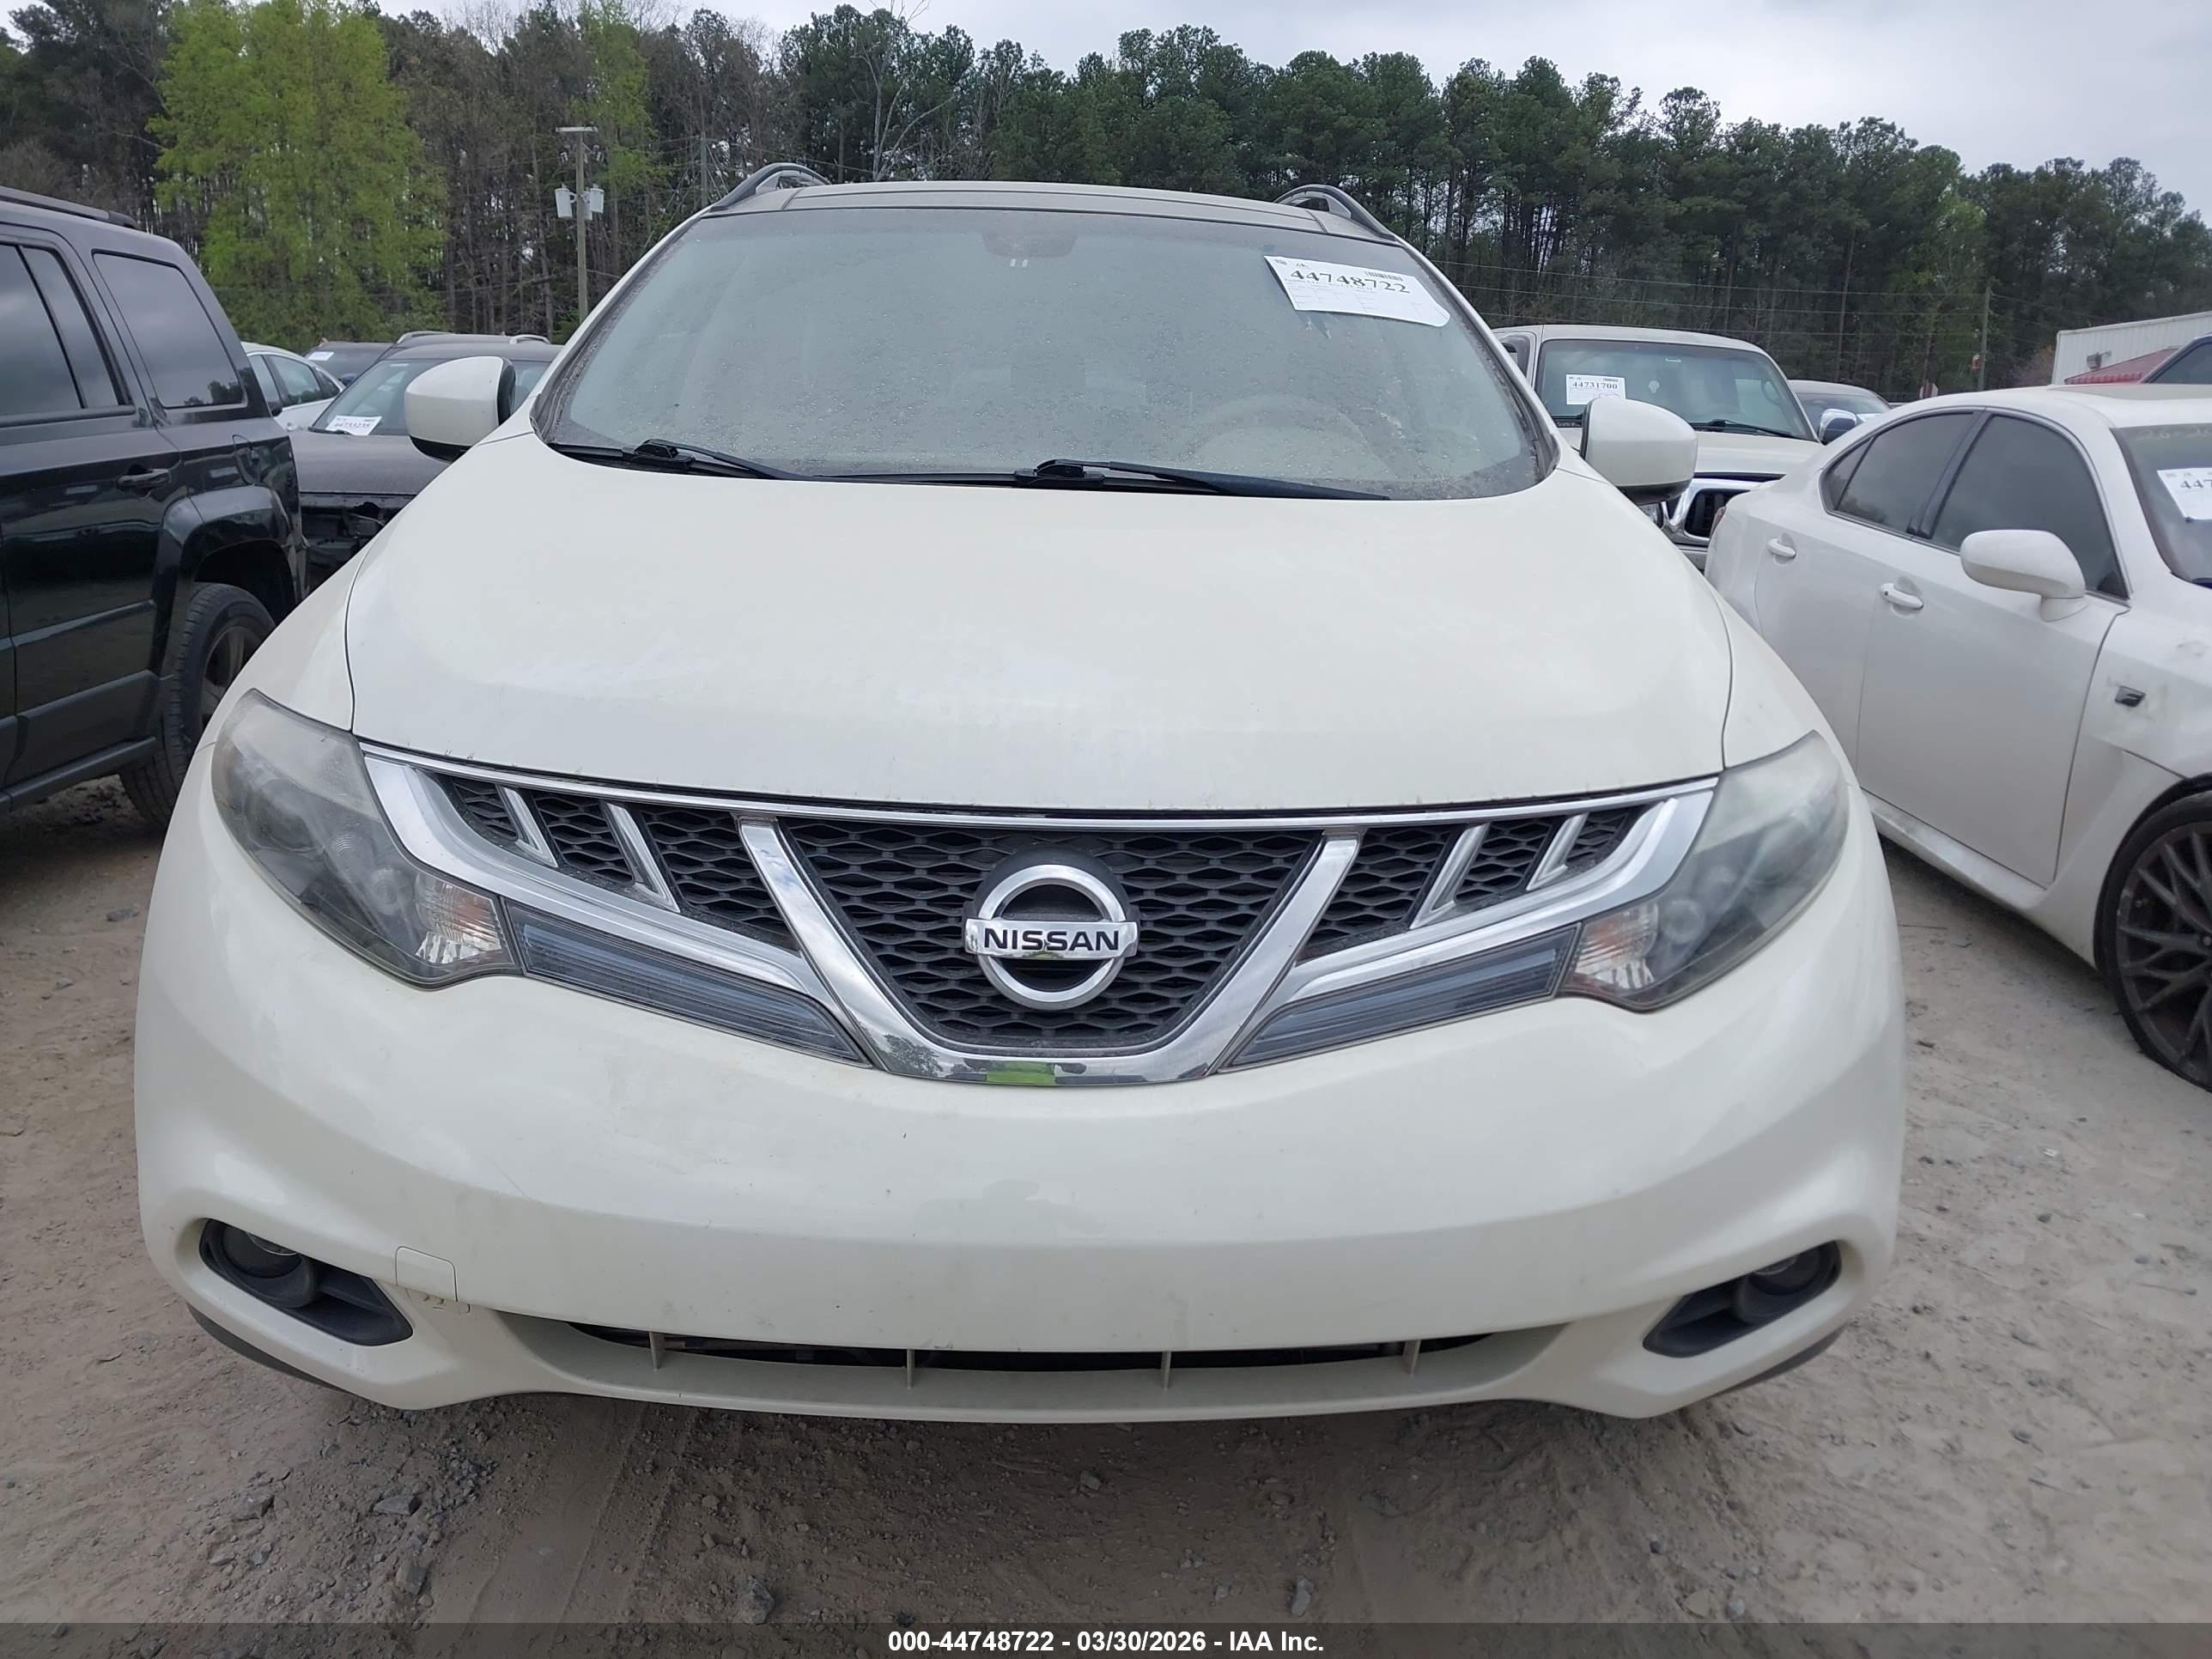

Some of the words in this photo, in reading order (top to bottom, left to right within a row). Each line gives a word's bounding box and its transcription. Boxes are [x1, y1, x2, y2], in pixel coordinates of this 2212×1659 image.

[1291, 270, 1411, 294] 44748722
[1572, 381, 1618, 390] 44731700
[984, 927, 1120, 951] NISSAN
